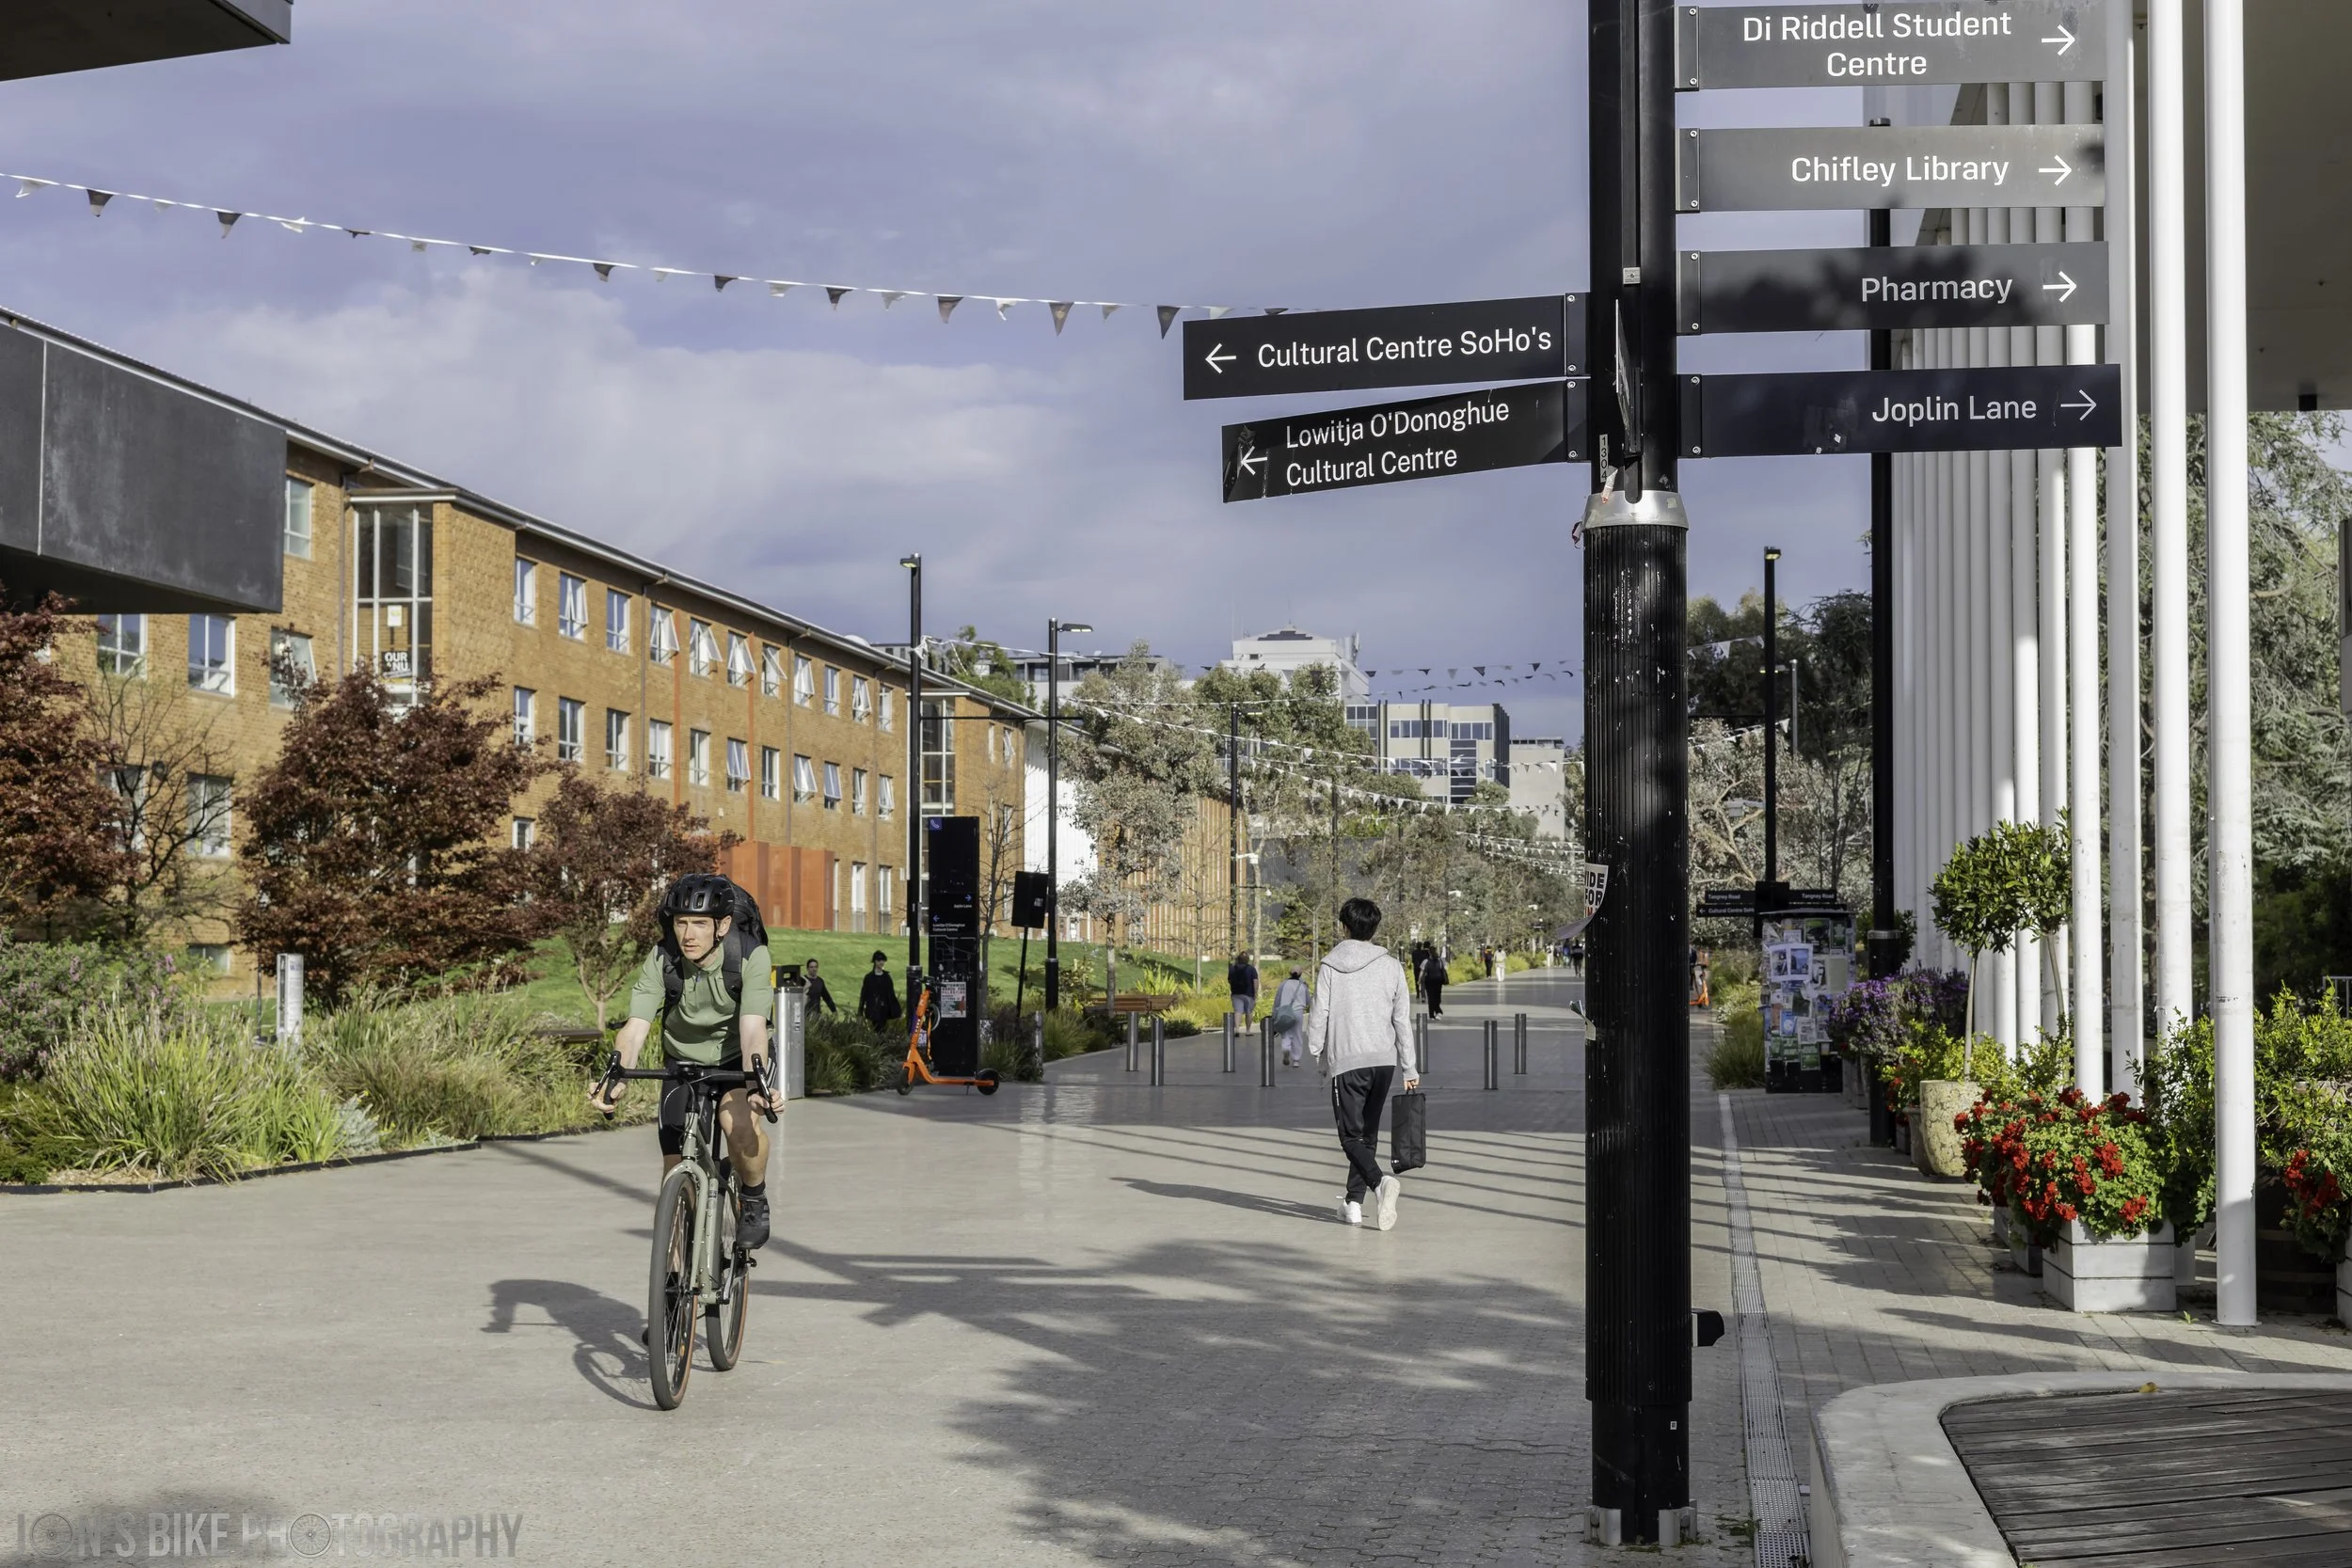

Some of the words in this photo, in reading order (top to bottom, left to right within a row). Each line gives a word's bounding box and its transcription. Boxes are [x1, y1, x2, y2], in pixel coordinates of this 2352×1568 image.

[1742, 16, 1772, 41] Di
[1781, 12, 1884, 40] Riddell
[1892, 10, 2012, 39] Student
[1826, 52, 1928, 77] Centre
[1790, 156, 1897, 188] Chifley
[1906, 155, 2010, 186] Library
[1861, 276, 2013, 305] Pharmacy
[1257, 337, 1358, 369] Cultural
[1365, 334, 1453, 362] Centre
[1459, 326, 1552, 356] SoHo's
[1285, 422, 1364, 451] Lowitja
[1370, 402, 1511, 436] O'Donoghue
[1870, 395, 1960, 428] Joplin
[1969, 395, 2038, 421] Lane
[1285, 454, 1374, 487] Cultural
[1381, 447, 1458, 473] Centre
[384, 651, 408, 663] OUR
